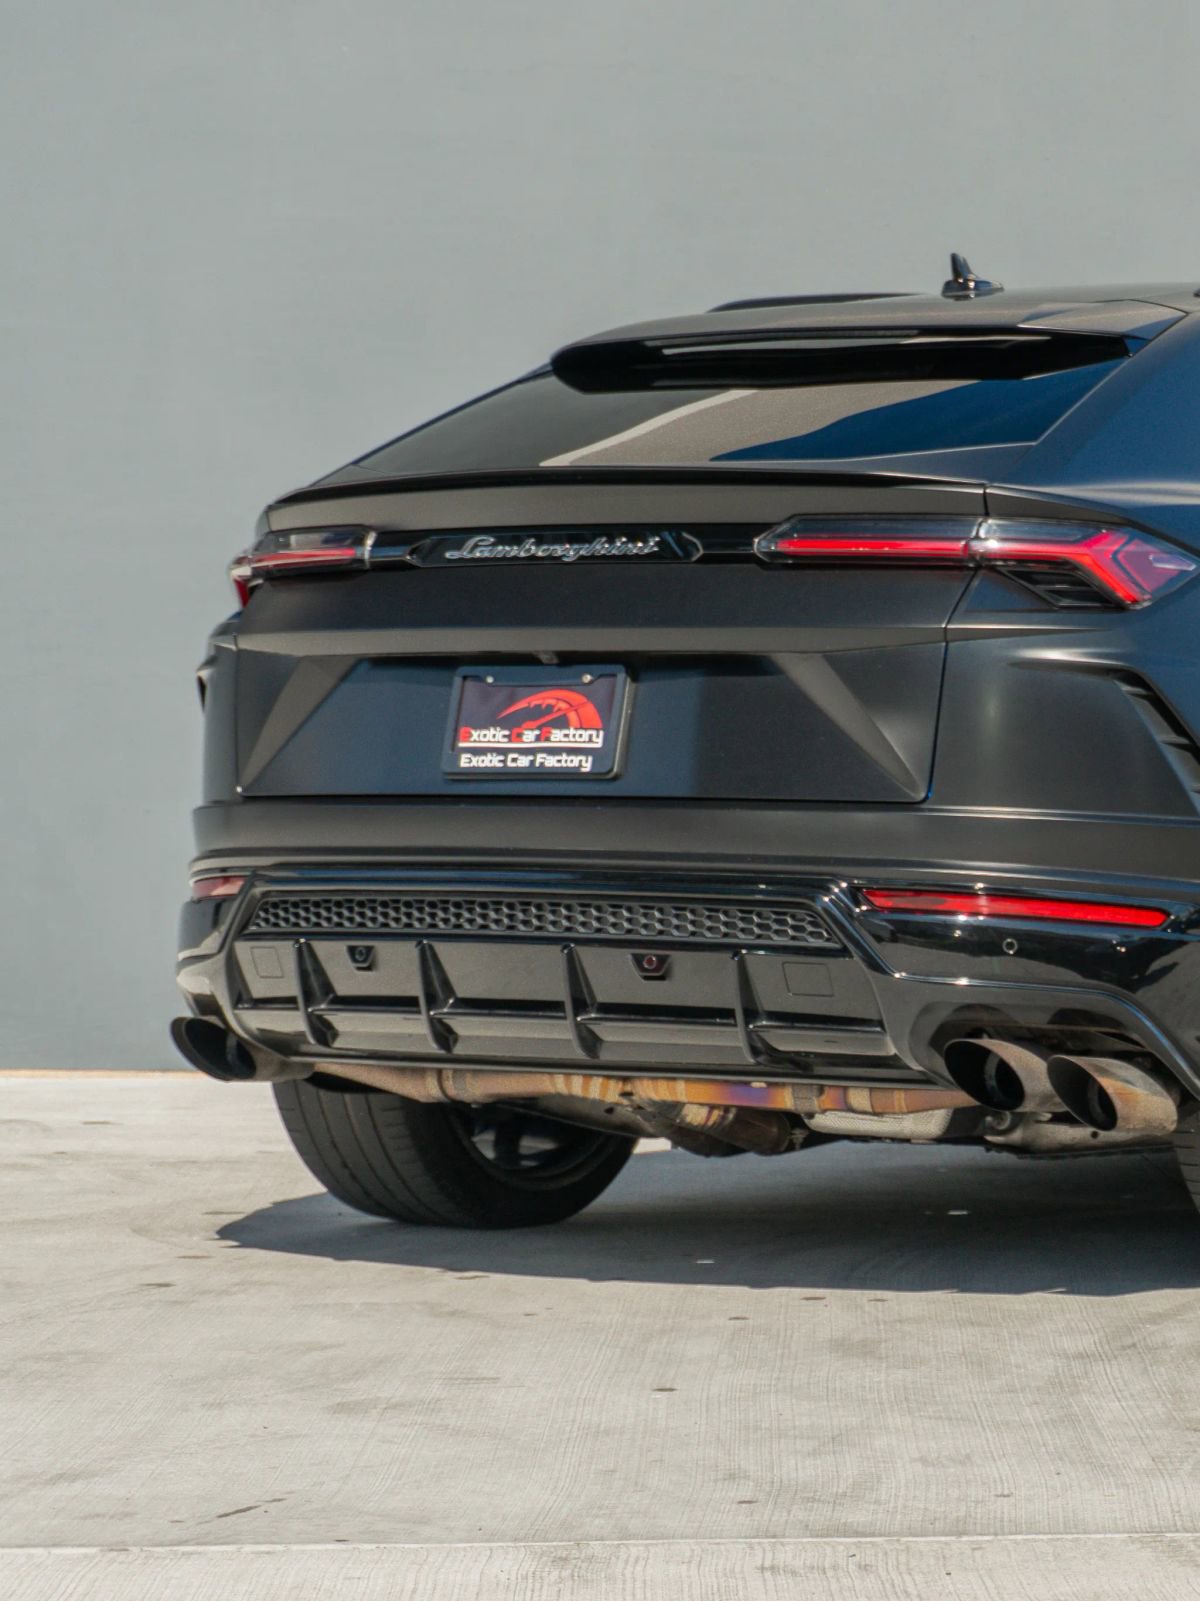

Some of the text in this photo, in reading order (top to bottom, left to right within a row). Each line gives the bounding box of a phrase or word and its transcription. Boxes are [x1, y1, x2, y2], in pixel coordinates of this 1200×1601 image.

[445, 535, 660, 562] Lamborghini
[459, 726, 604, 747] Exotic Car Factory
[460, 752, 593, 772] Exotic Car Factory
